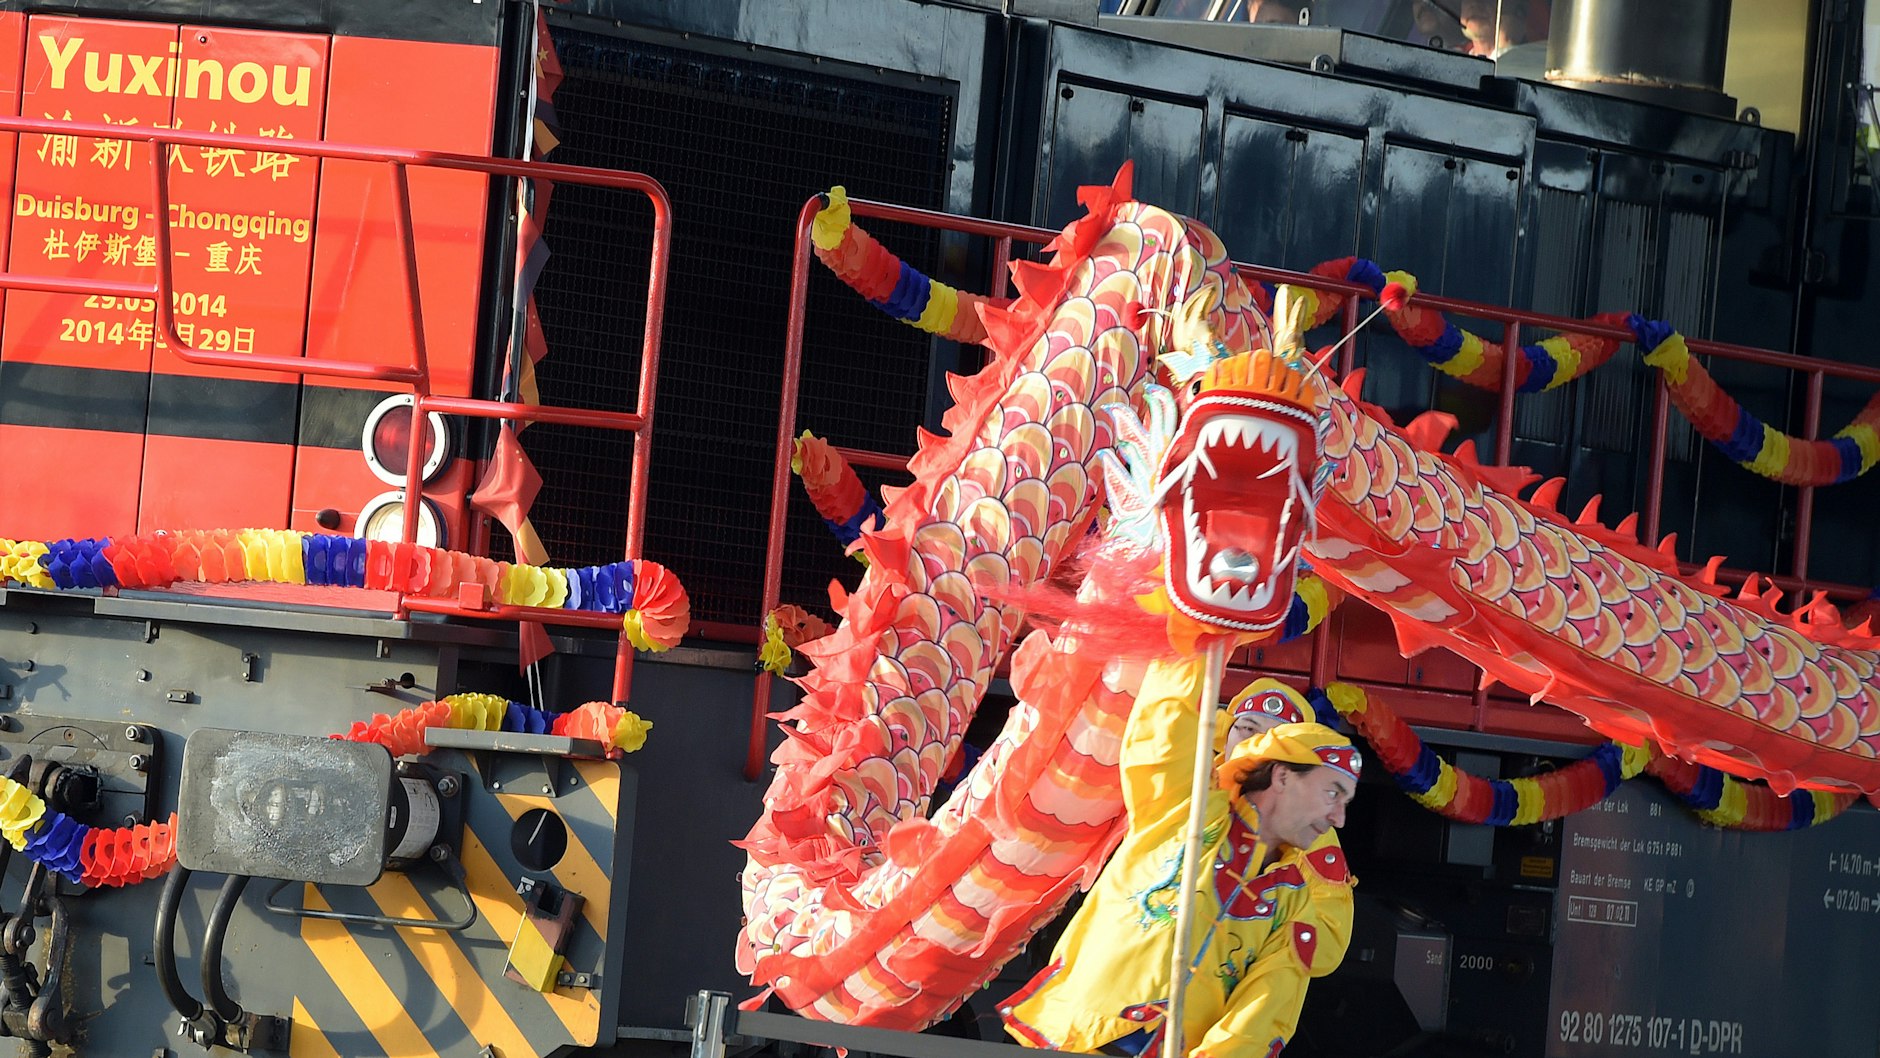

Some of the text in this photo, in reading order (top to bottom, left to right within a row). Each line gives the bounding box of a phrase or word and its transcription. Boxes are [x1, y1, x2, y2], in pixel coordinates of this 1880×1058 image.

[39, 35, 311, 107] Yuxinou
[16, 194, 140, 230] Duisburg
[42, 228, 157, 267] 杜伊斯堡
[204, 241, 263, 275] 重庆
[1617, 801, 1629, 814] Lok
[1573, 832, 1618, 852] Bremsgewicht
[1620, 838, 1630, 851] der
[1633, 839, 1645, 854] Lok
[1570, 869, 1592, 885] Bauart
[1593, 873, 1605, 886] der
[1607, 874, 1631, 889] Bremse
[1425, 949, 1443, 965] Sand
[1460, 954, 1494, 971] 2000
[1560, 1010, 1743, 1055] 92 80 1275 107-1 D-DPR
